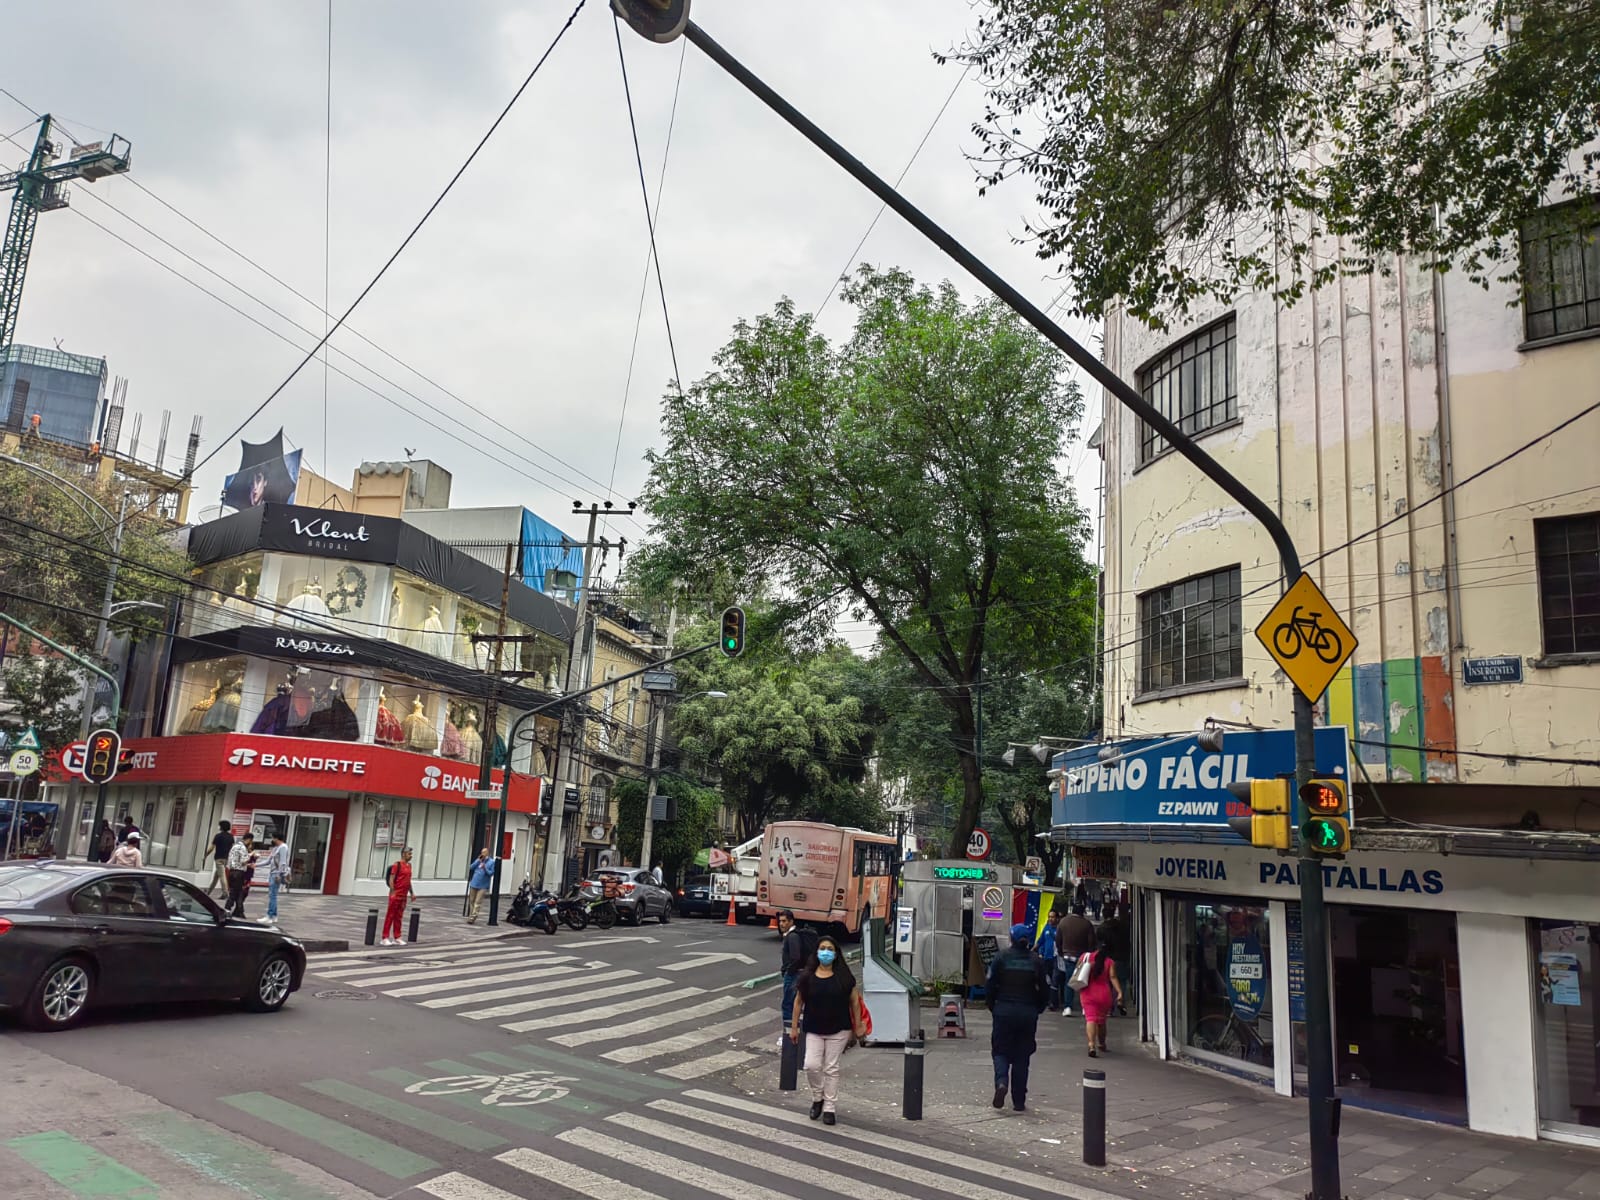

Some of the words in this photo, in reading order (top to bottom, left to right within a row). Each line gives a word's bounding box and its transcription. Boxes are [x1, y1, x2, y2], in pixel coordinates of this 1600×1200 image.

[290, 518, 370, 541] Klent
[308, 540, 348, 551] BRIDAL
[1477, 659, 1506, 667] AVENIDA
[1469, 665, 1515, 676] INSURGENTES
[18, 755, 32, 765] 50
[260, 753, 366, 774] BANORTE
[1158, 745, 1254, 790] FÁCIL
[969, 834, 984, 847] 40
[1155, 857, 1227, 880] JOYERIA
[1260, 862, 1444, 894] PATALLAS
[1232, 943, 1246, 954] HOY
